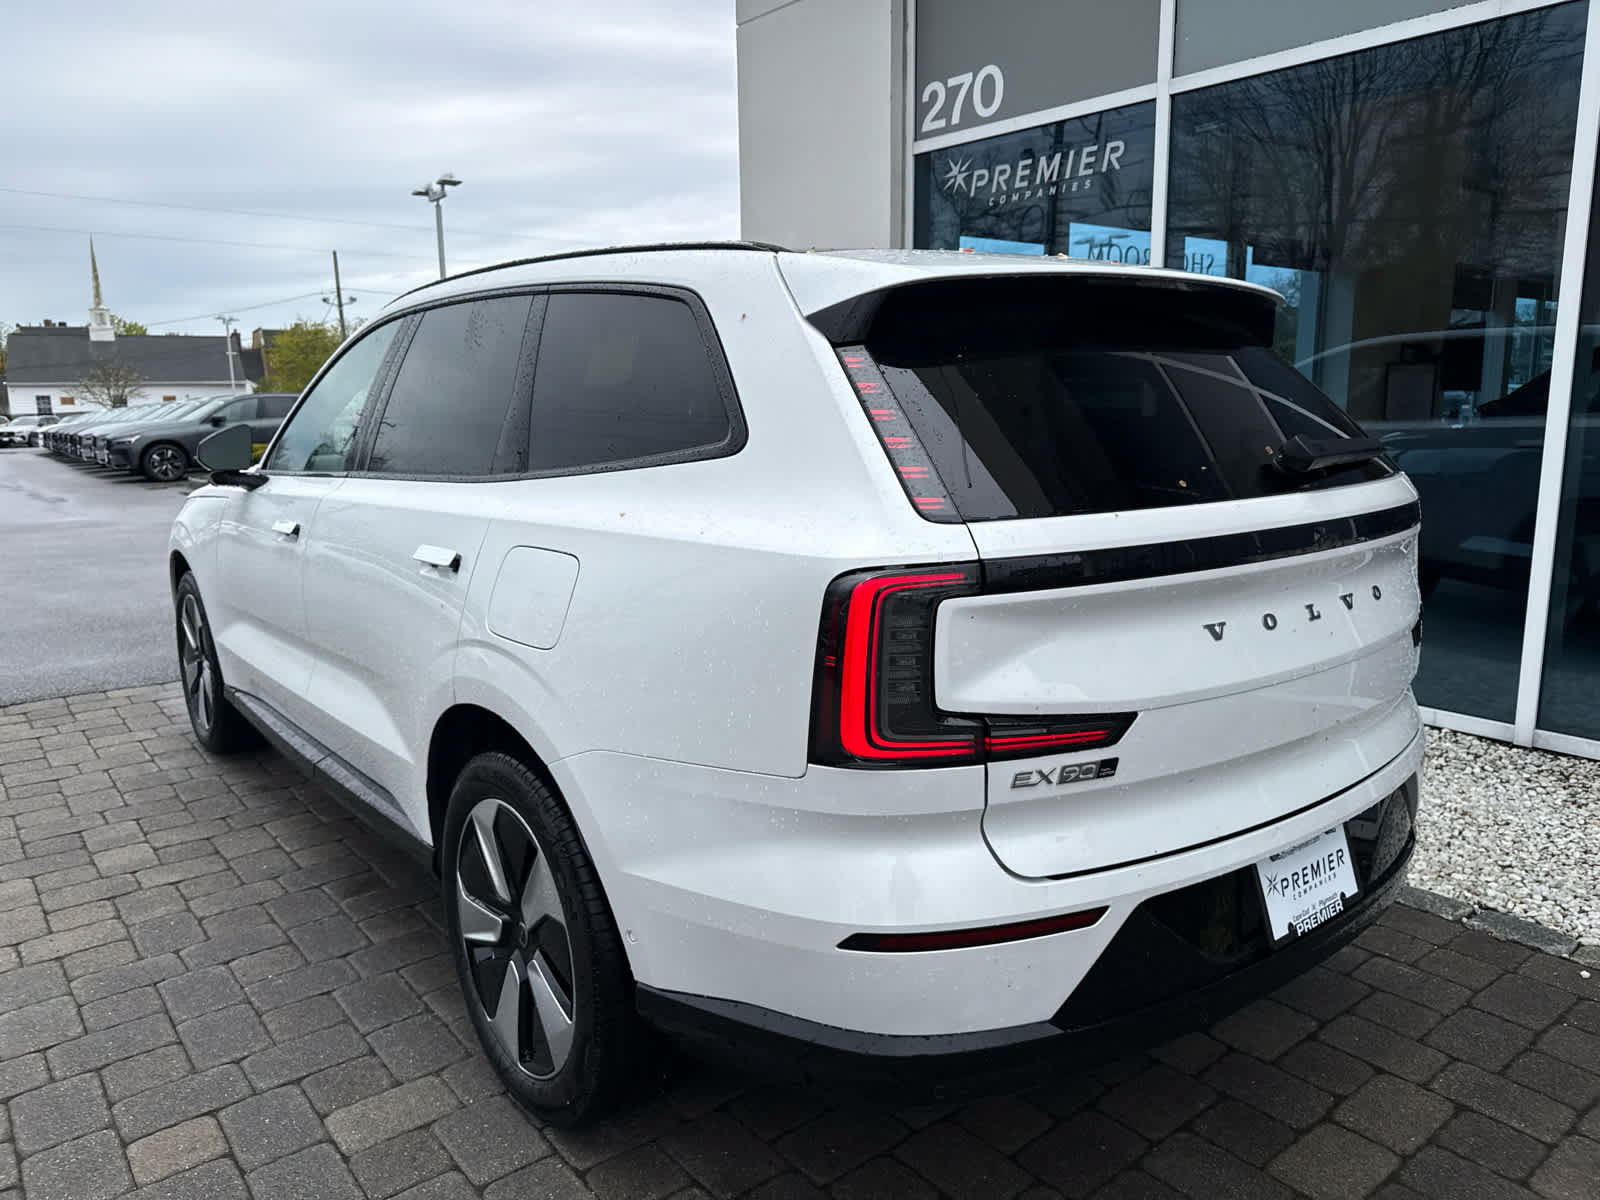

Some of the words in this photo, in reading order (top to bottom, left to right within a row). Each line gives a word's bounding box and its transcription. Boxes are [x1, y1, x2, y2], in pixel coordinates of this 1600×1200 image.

[921, 64, 1004, 132] 270
[970, 140, 1125, 197] PREMIER
[988, 179, 1092, 206] COMPANIES
[1203, 584, 1382, 642] VOLVO
[1010, 761, 1099, 789] EX90
[1280, 848, 1345, 897] PREMIER
[1295, 901, 1344, 936] PREMIER
